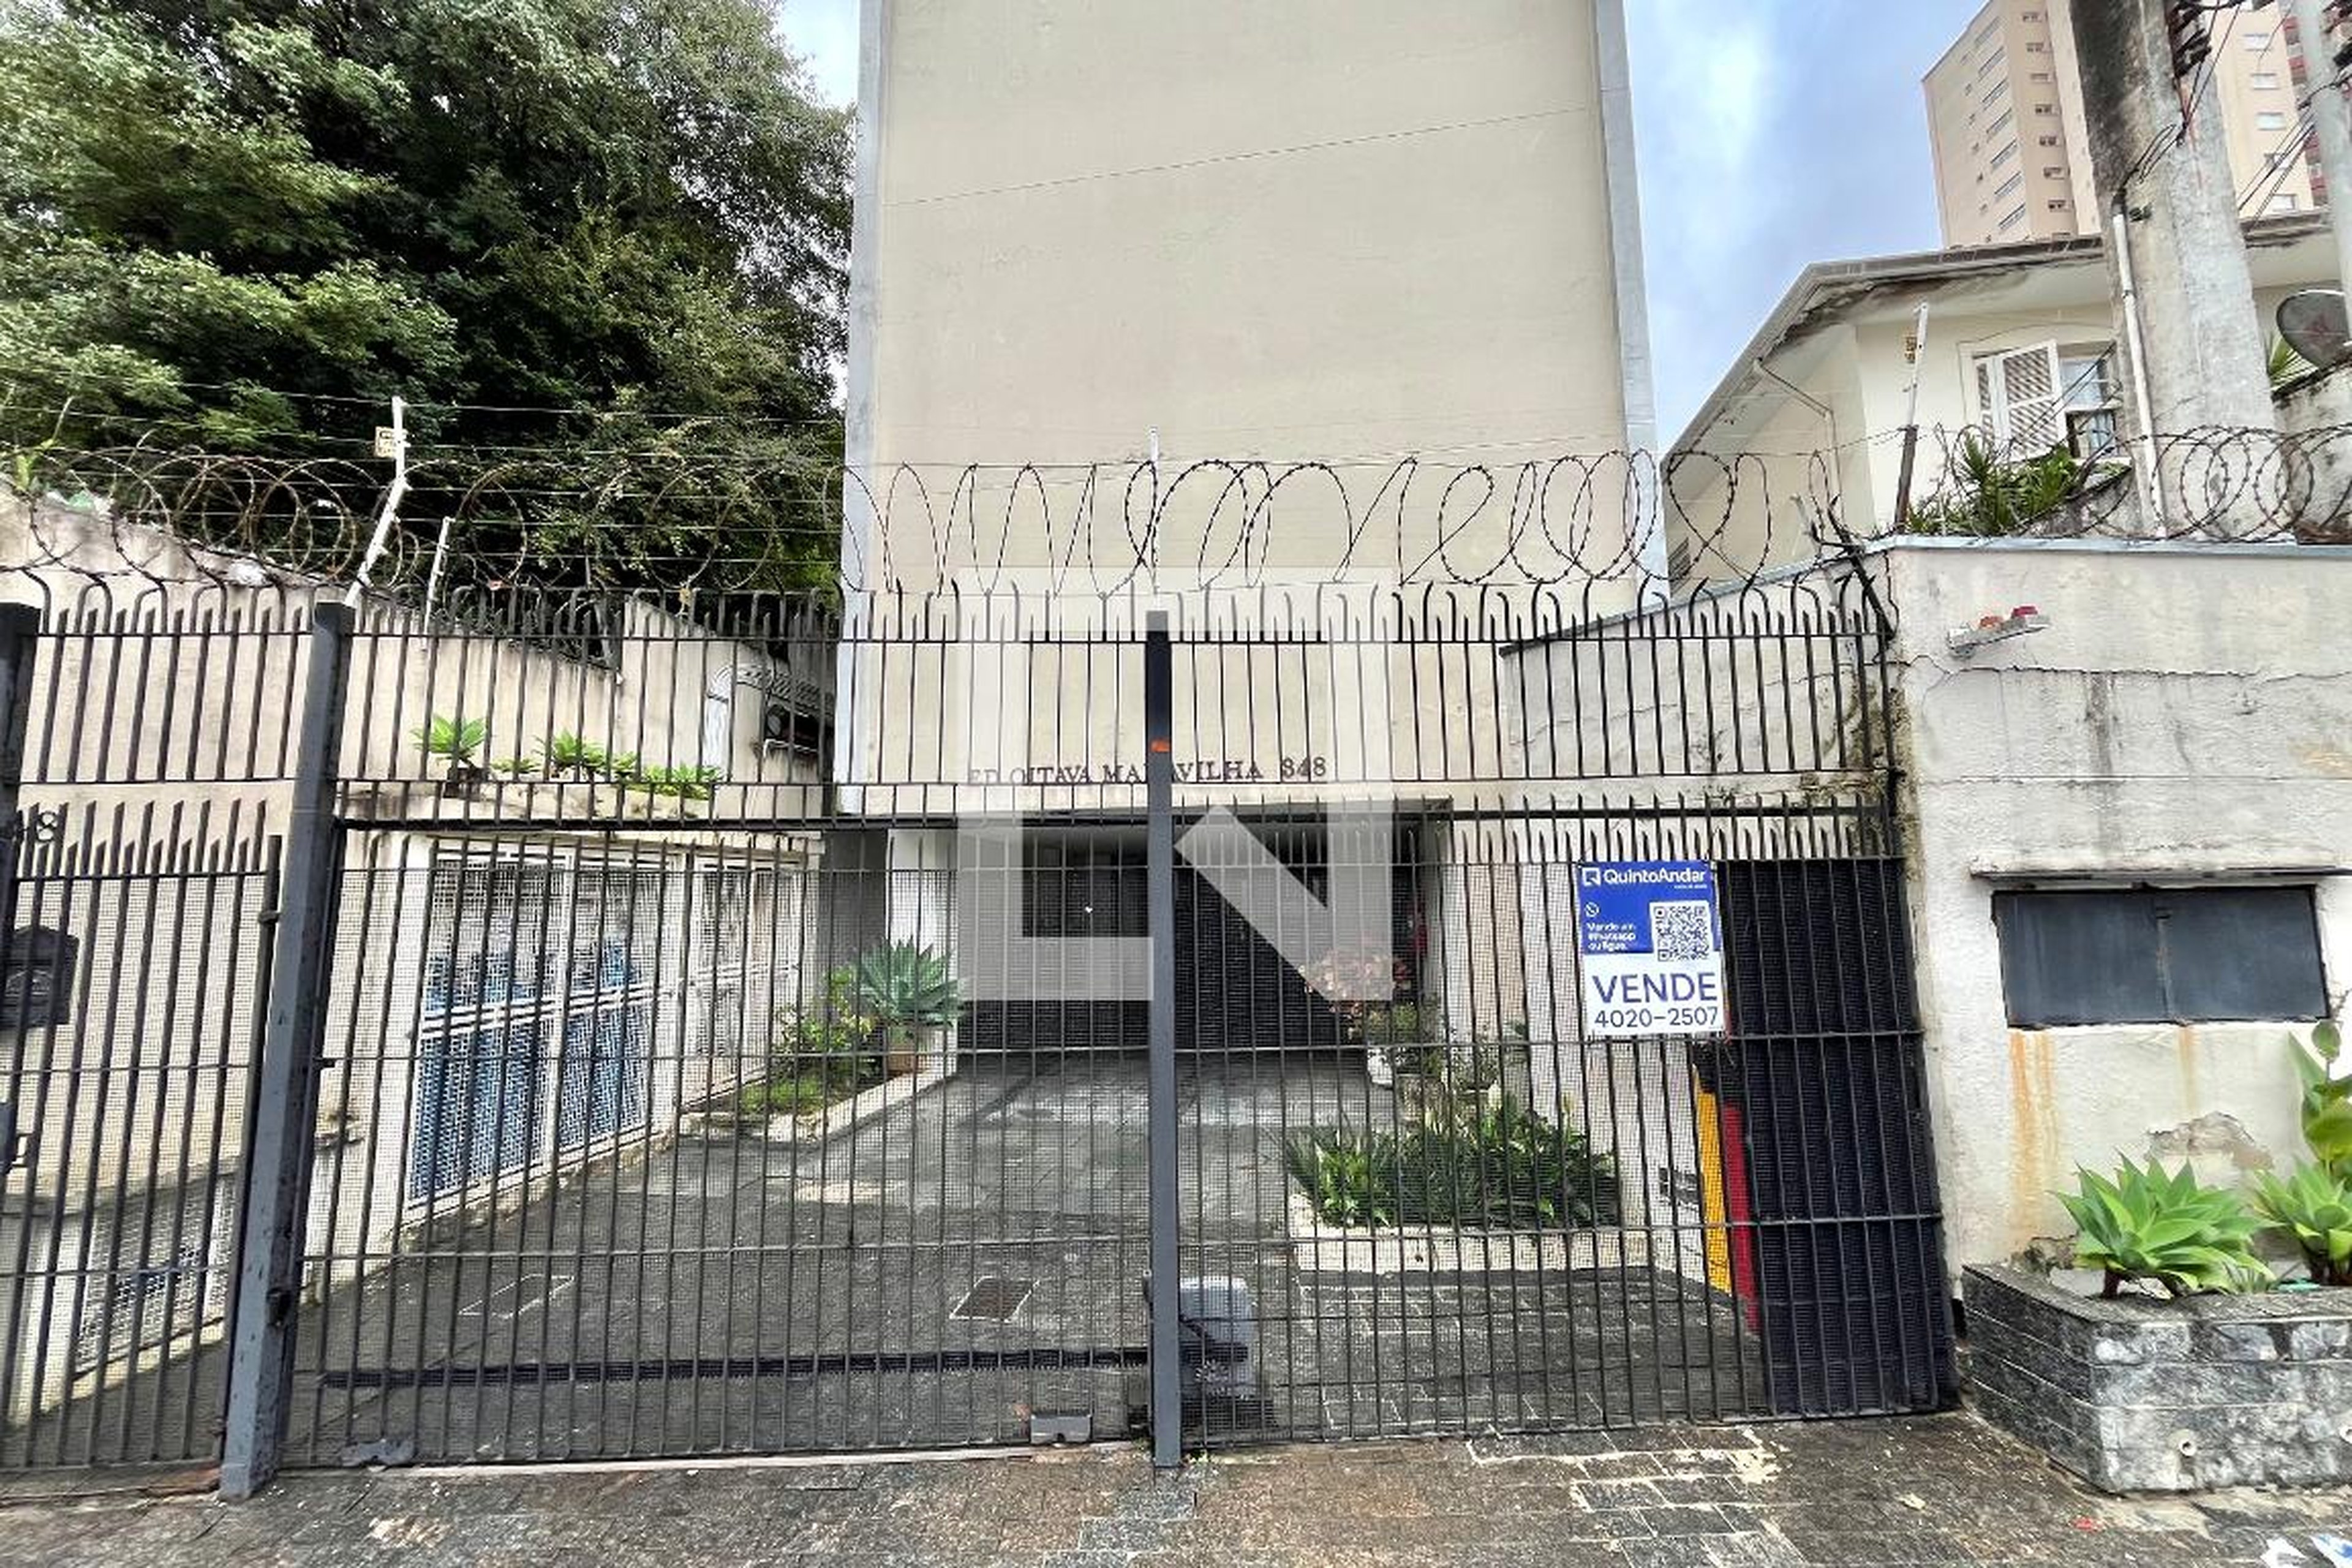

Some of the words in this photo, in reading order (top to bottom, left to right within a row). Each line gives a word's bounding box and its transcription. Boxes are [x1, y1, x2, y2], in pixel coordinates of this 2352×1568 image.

[1102, 761, 1263, 783] MAVILHA
[1603, 867, 1706, 884] QuintoAndar
[1592, 972, 1717, 1003] VENDE
[1594, 1006, 1718, 1028] 4020-2507
